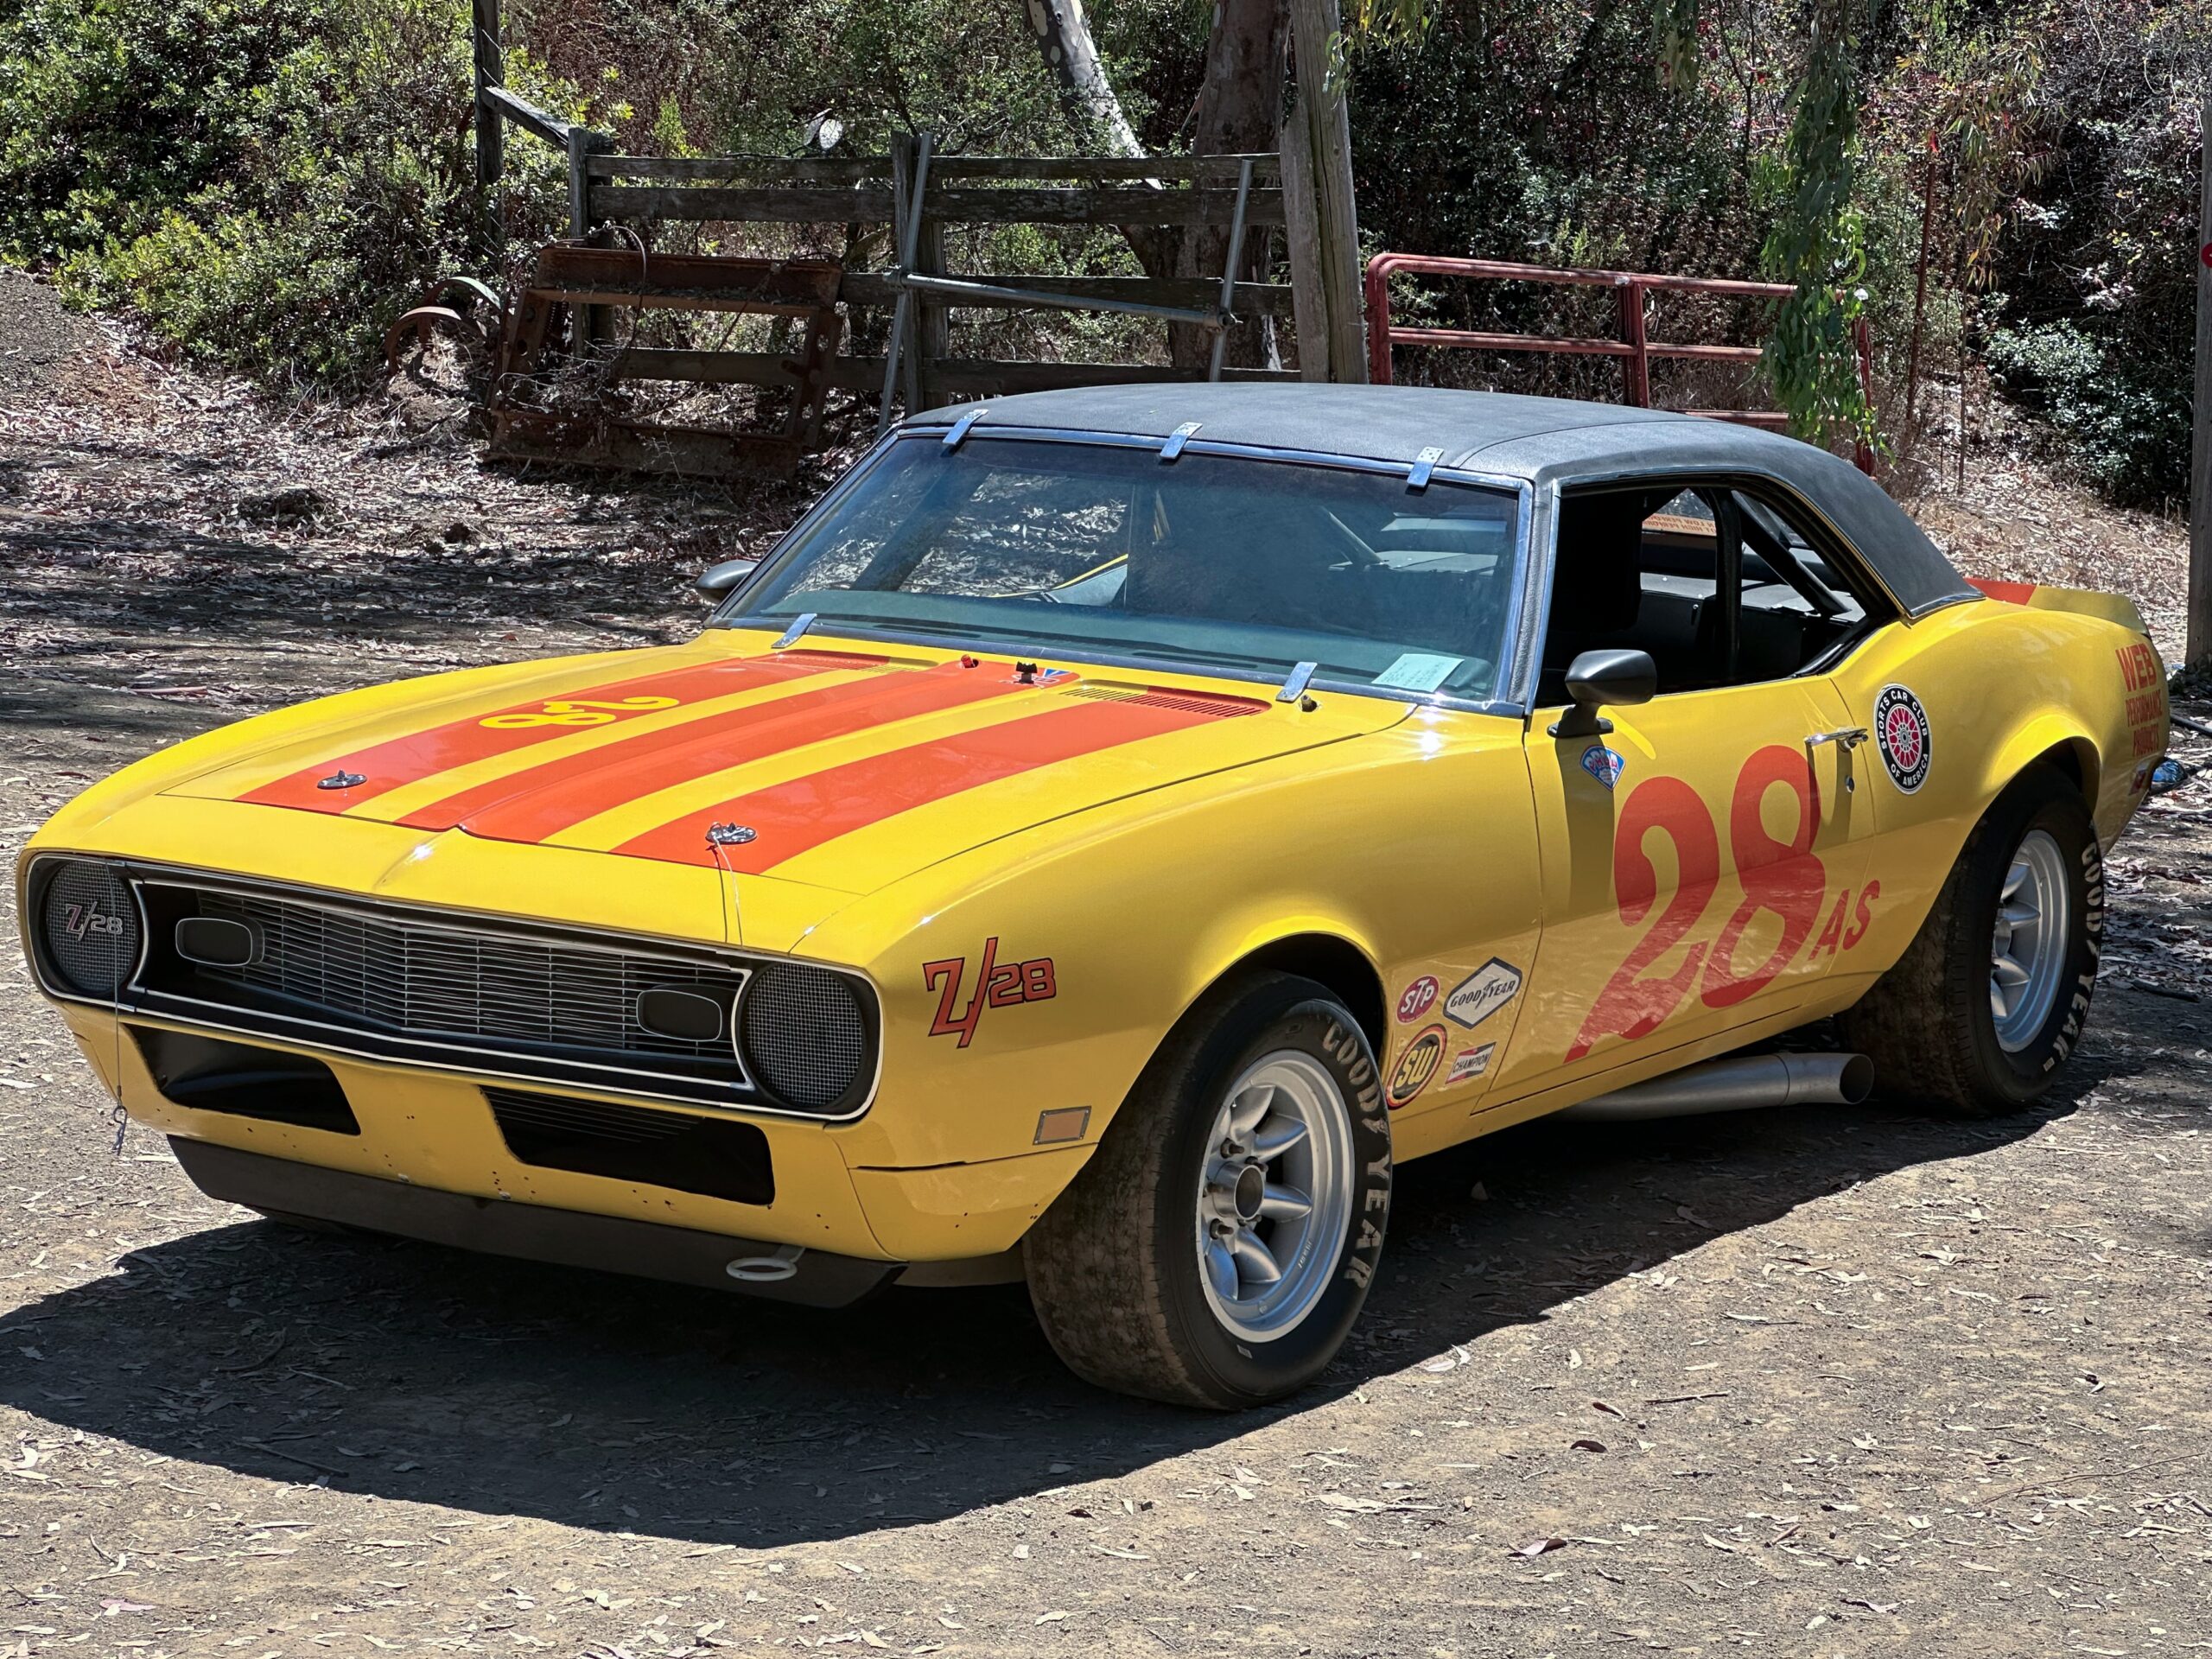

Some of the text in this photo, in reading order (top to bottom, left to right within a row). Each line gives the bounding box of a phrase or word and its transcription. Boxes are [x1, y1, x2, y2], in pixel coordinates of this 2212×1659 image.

[2115, 643, 2157, 691] WEB
[479, 696, 679, 728] 28
[1878, 690, 1928, 749] SPORTS CAR CLUB
[1891, 753, 1929, 786] OF AMERICA
[65, 901, 123, 941] Z/28
[1563, 745, 1880, 1063] 28 AS
[922, 937, 1057, 1048] Z/28
[1401, 978, 1435, 1014] STP
[1395, 1045, 1438, 1088] SW
[1452, 1053, 1490, 1072] CHAMPION
